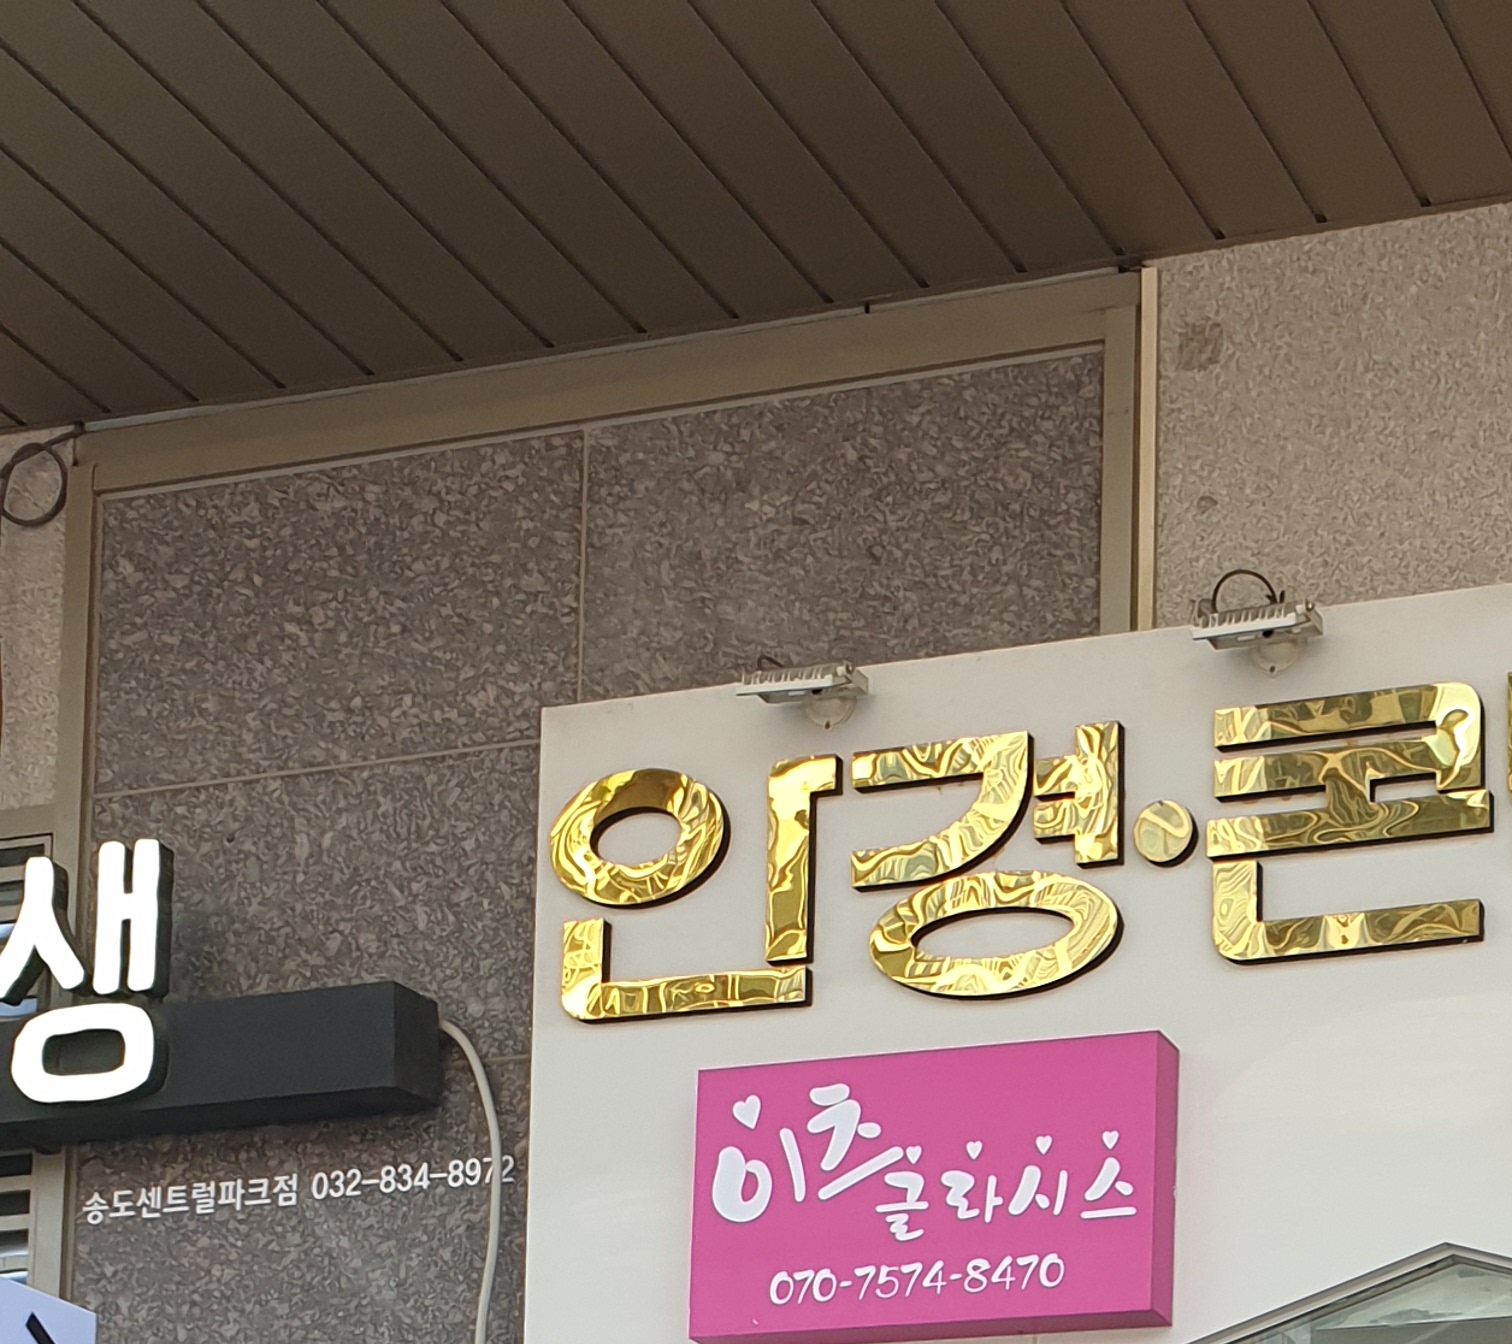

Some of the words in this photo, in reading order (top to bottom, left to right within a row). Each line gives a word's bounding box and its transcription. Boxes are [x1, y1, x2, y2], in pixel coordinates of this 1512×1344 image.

[82, 1173, 299, 1226] 송도센트럴파크점
[311, 1155, 517, 1202] 032-834-8972
[769, 1252, 1066, 1306] 070-7574-8470
